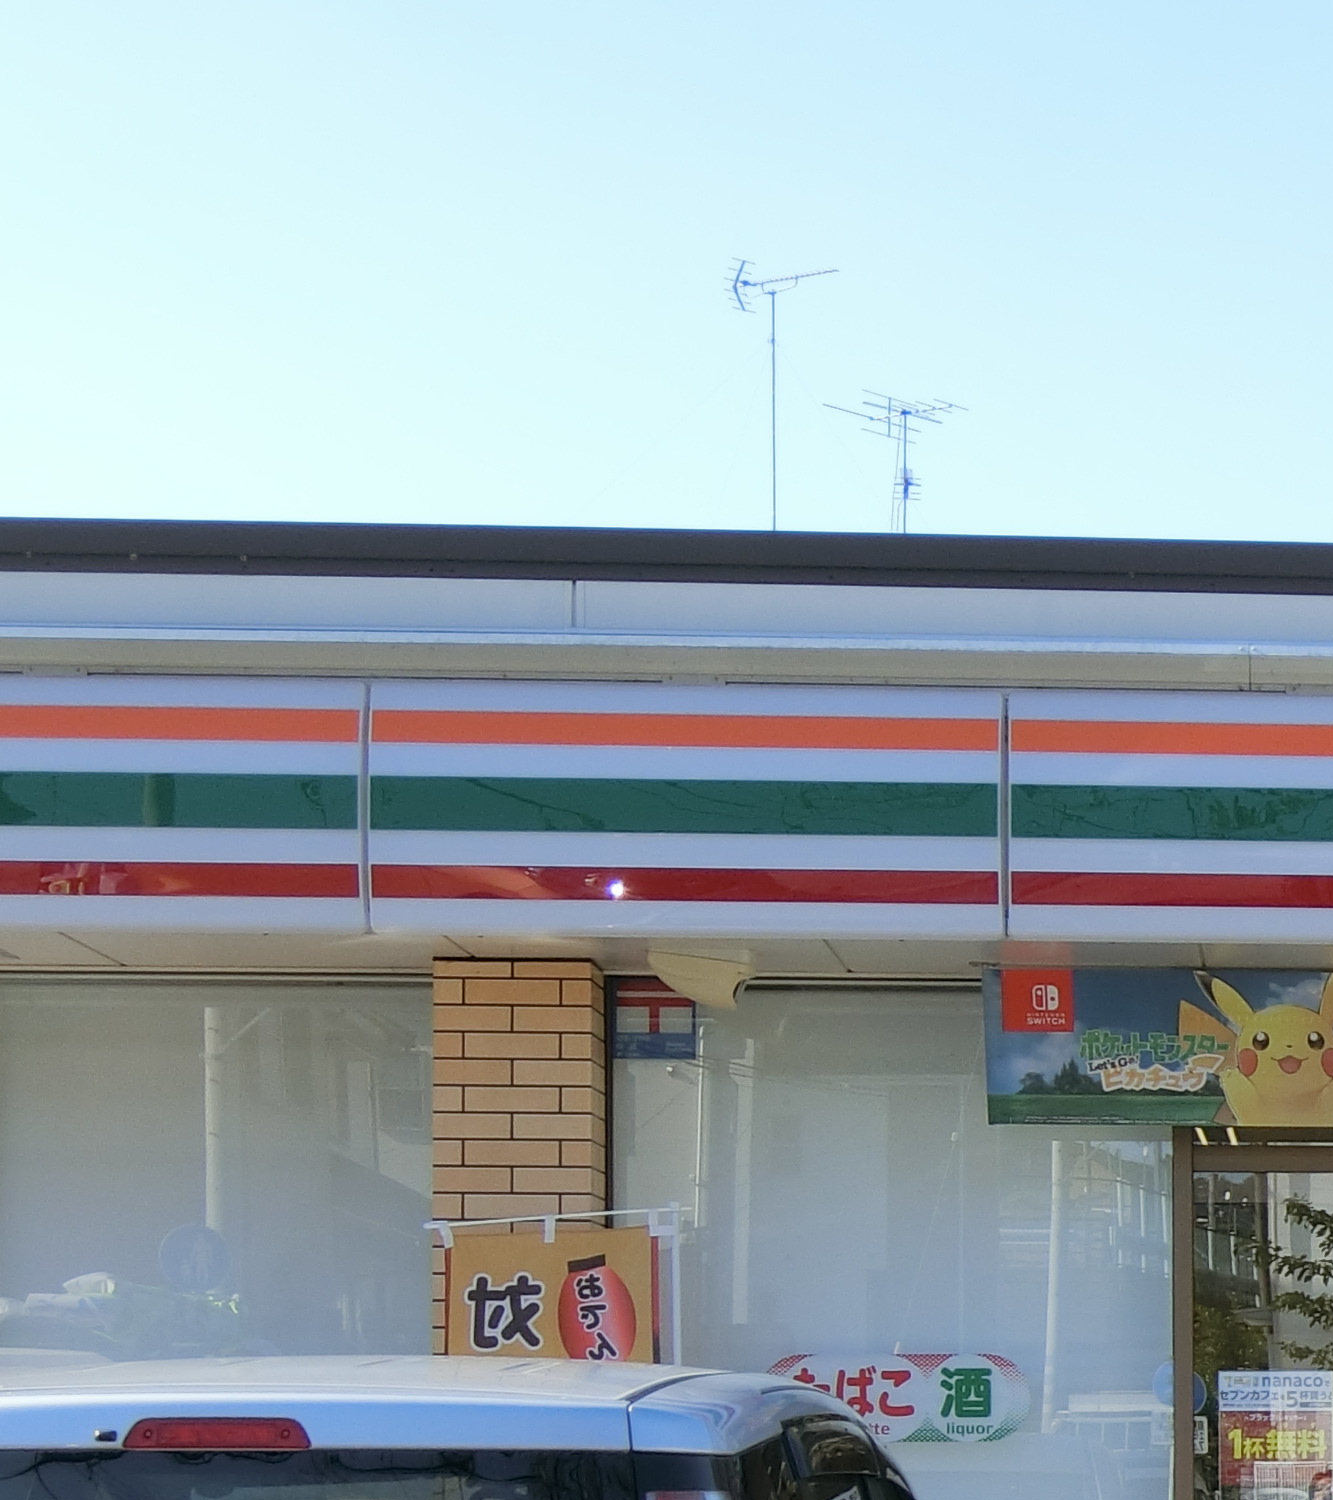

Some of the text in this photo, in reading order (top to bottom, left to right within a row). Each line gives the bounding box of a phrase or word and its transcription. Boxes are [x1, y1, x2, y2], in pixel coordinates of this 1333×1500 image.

[1027, 1017, 1065, 1025] SWITCH
[1080, 1030, 1230, 1063] ポケットモンスター
[1102, 1056, 1224, 1092] ピカチュウ
[940, 1367, 992, 1417] 酒
[946, 1423, 994, 1436] liquor
[1228, 1428, 1327, 1460] 1杯無料
